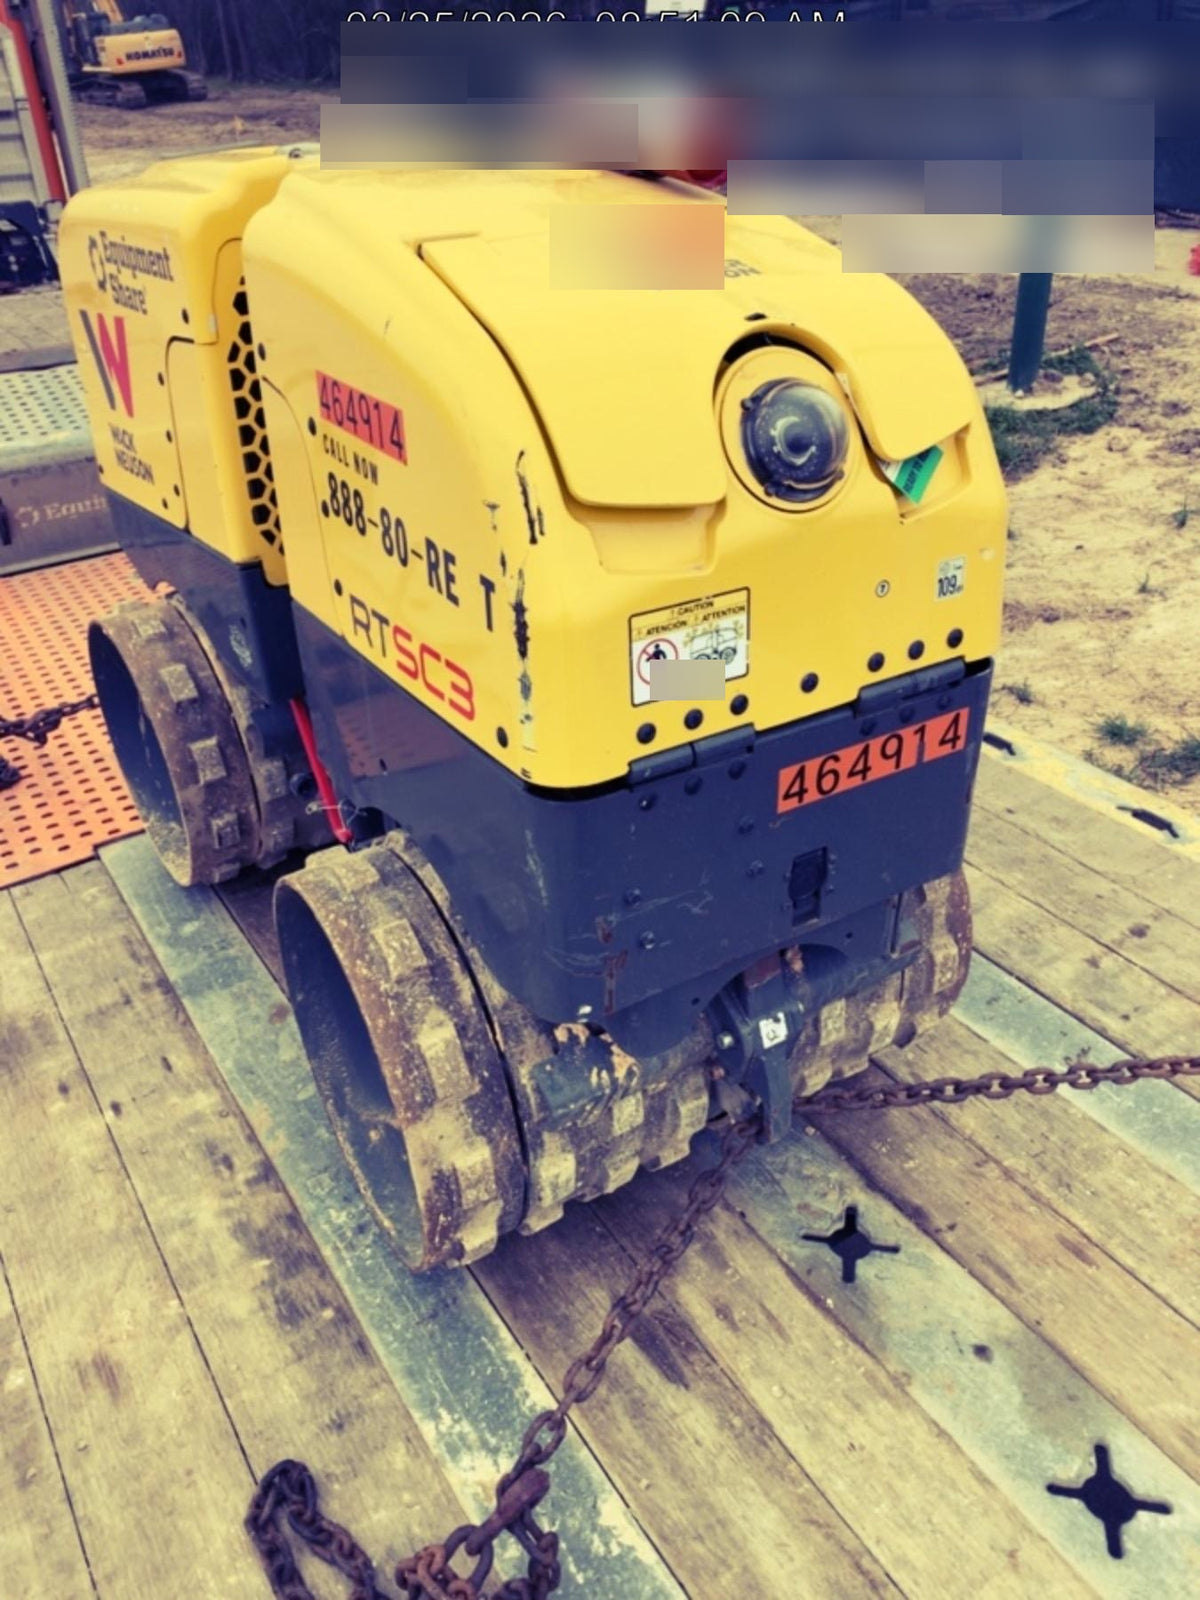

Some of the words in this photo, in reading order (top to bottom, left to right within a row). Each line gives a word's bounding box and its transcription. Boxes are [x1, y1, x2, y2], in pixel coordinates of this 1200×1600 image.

[125, 47, 174, 60] KOMATSU
[99, 231, 174, 282] Equipment
[109, 273, 148, 315] Share
[320, 376, 403, 460] 464914
[114, 447, 155, 485] NEUSON
[323, 433, 350, 467] CALL
[353, 450, 379, 485] NOW
[937, 574, 958, 598] 109
[677, 600, 715, 616] CAUTION
[702, 605, 746, 622] ATTENTION
[349, 593, 475, 721] RTSC3
[782, 712, 962, 804] 464914
